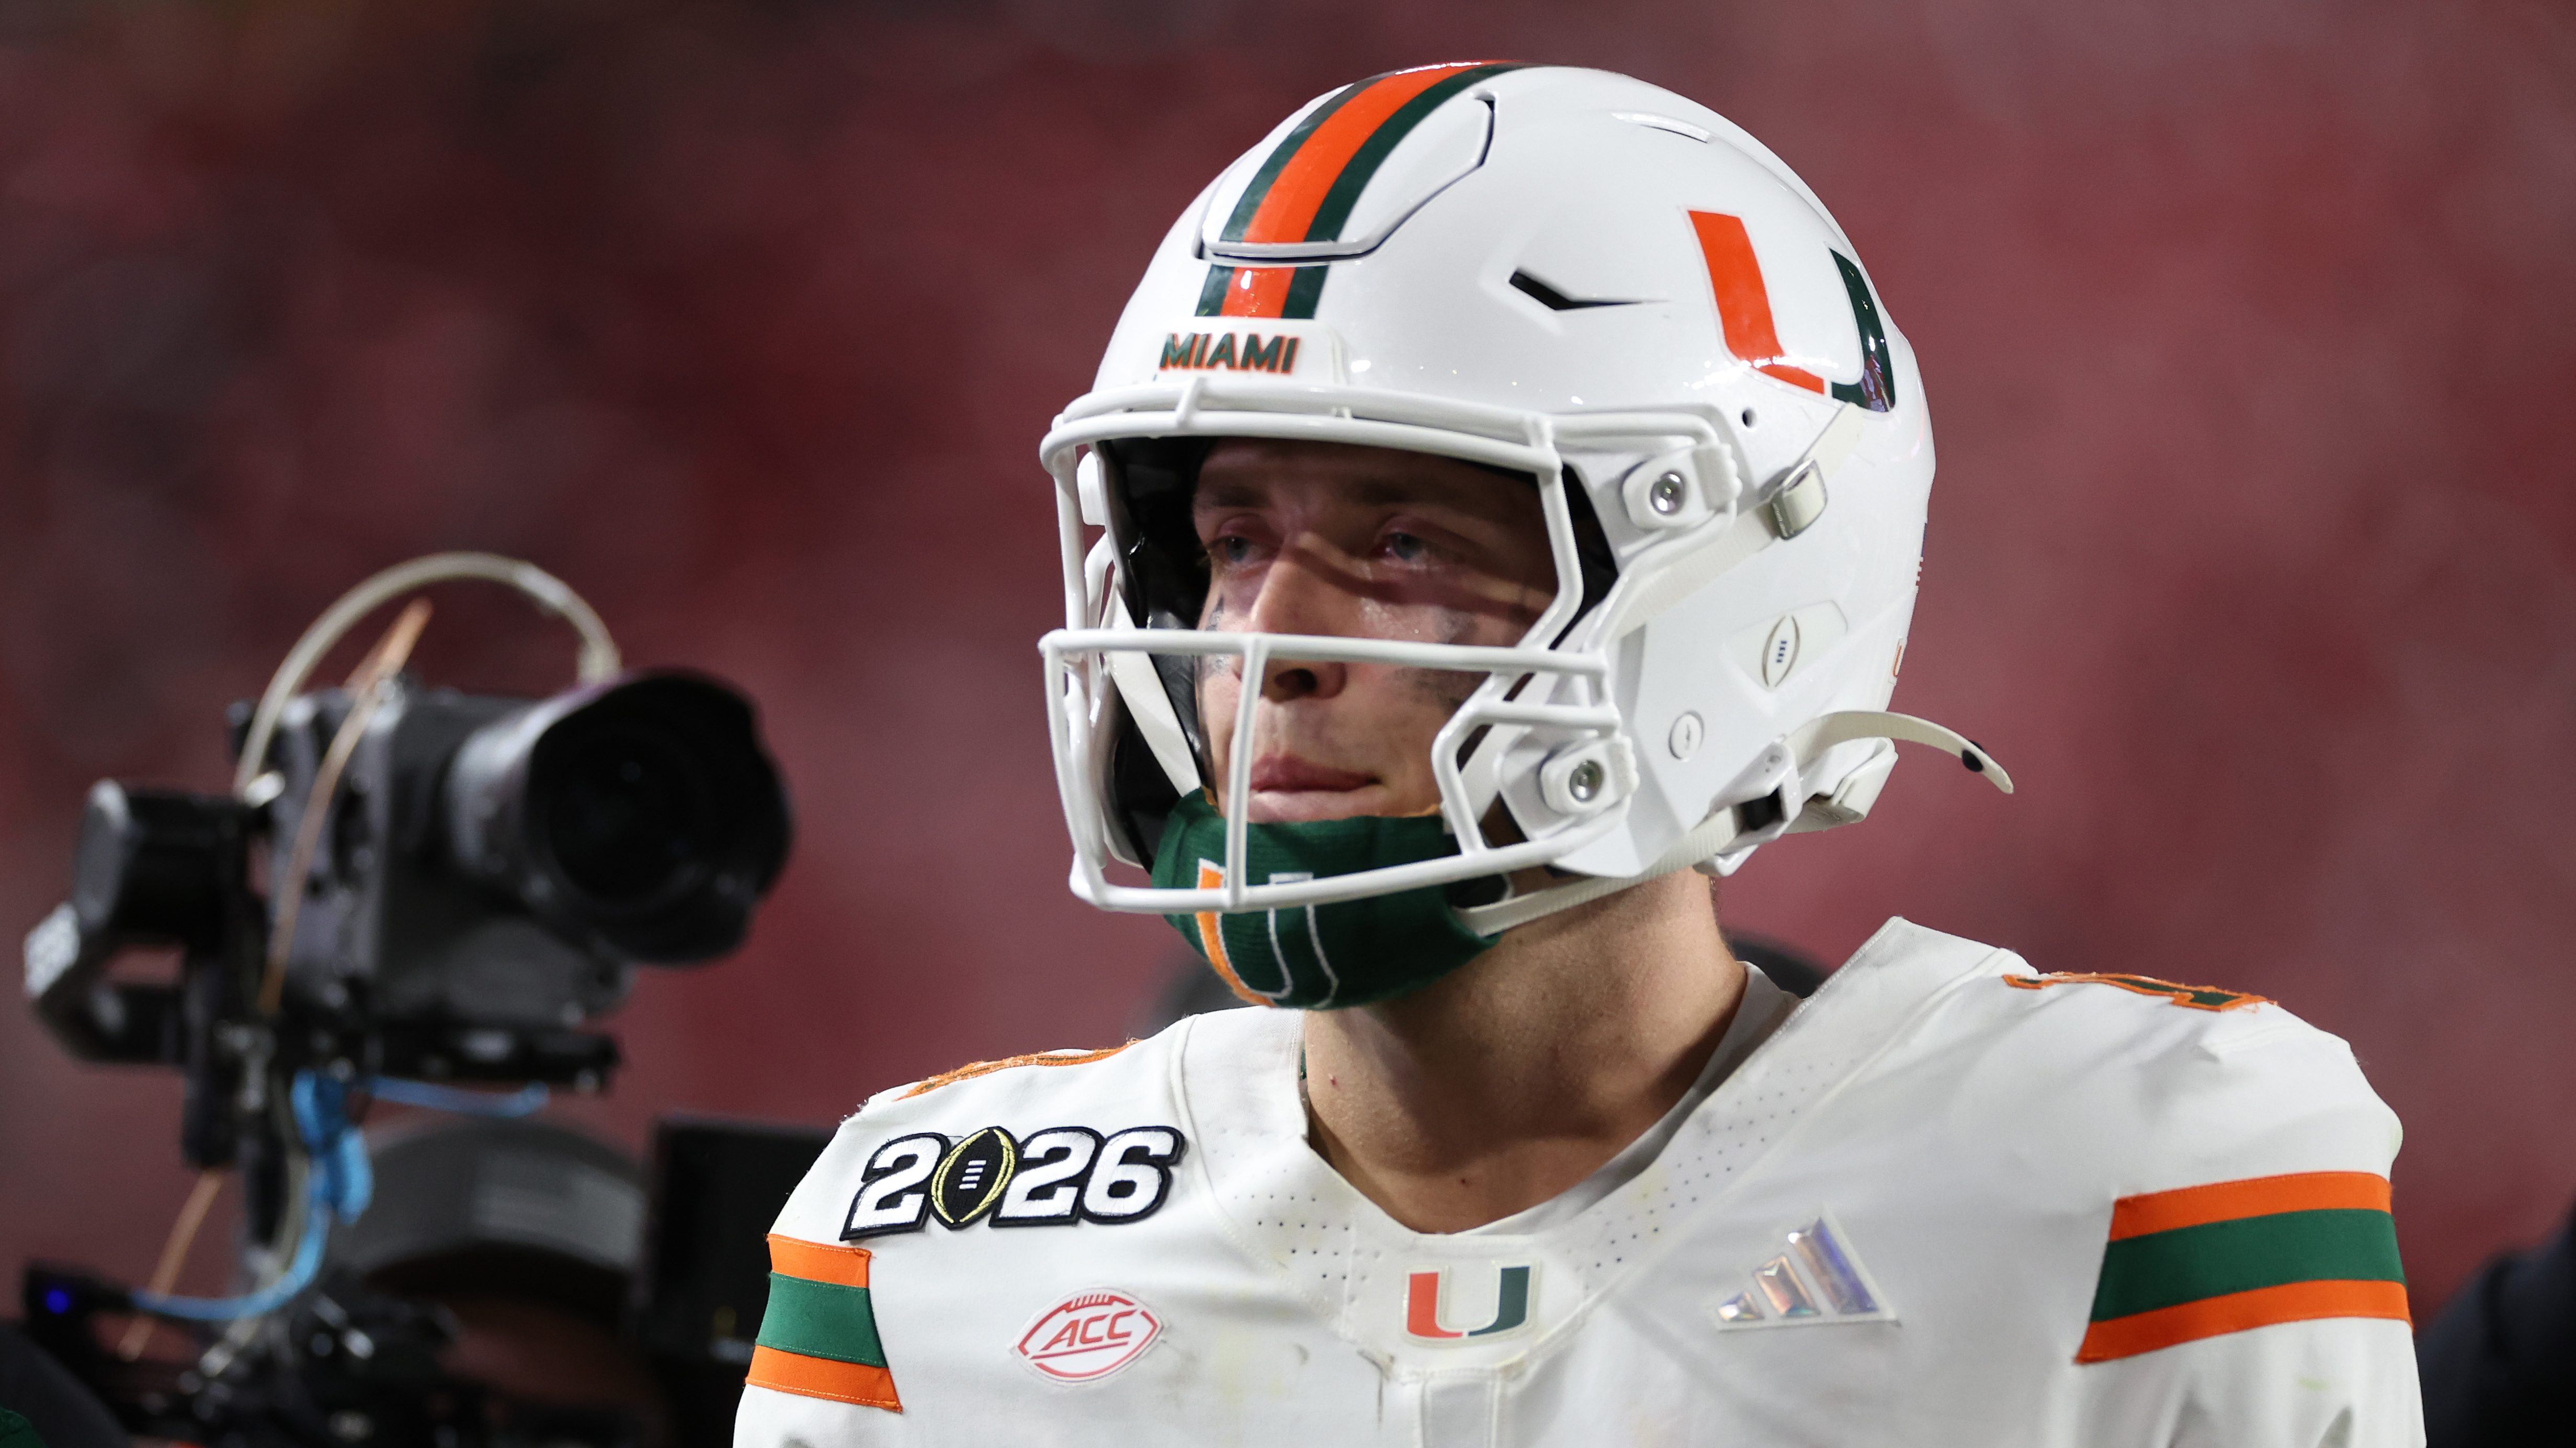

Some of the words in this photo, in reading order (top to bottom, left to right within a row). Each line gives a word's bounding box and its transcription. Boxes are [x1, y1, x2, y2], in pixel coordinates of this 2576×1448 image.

[1687, 210, 1896, 413] U
[1159, 332, 1300, 375] MIAMI
[839, 1126, 1188, 1241] 2026
[1040, 1309, 1138, 1351] ACC
[1407, 1266, 1530, 1338] U
